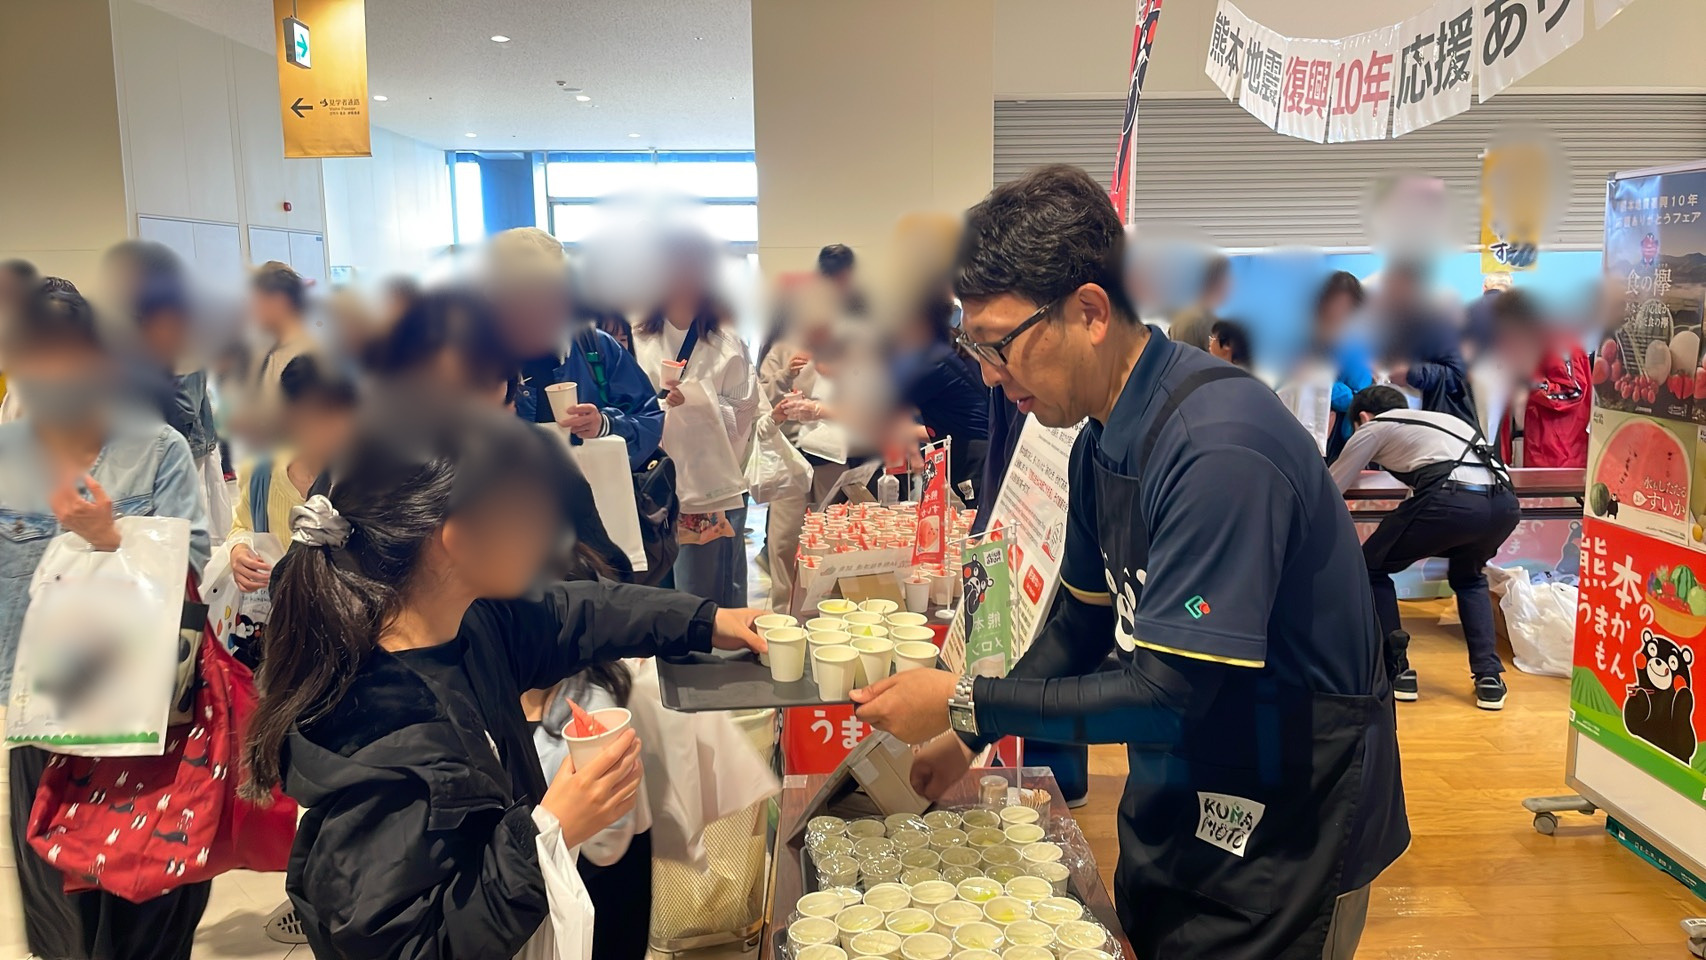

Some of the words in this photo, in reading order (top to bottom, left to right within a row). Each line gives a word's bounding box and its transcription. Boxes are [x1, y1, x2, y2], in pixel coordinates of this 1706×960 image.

[1647, 491, 1686, 516] すいか
[811, 710, 876, 749] うま
